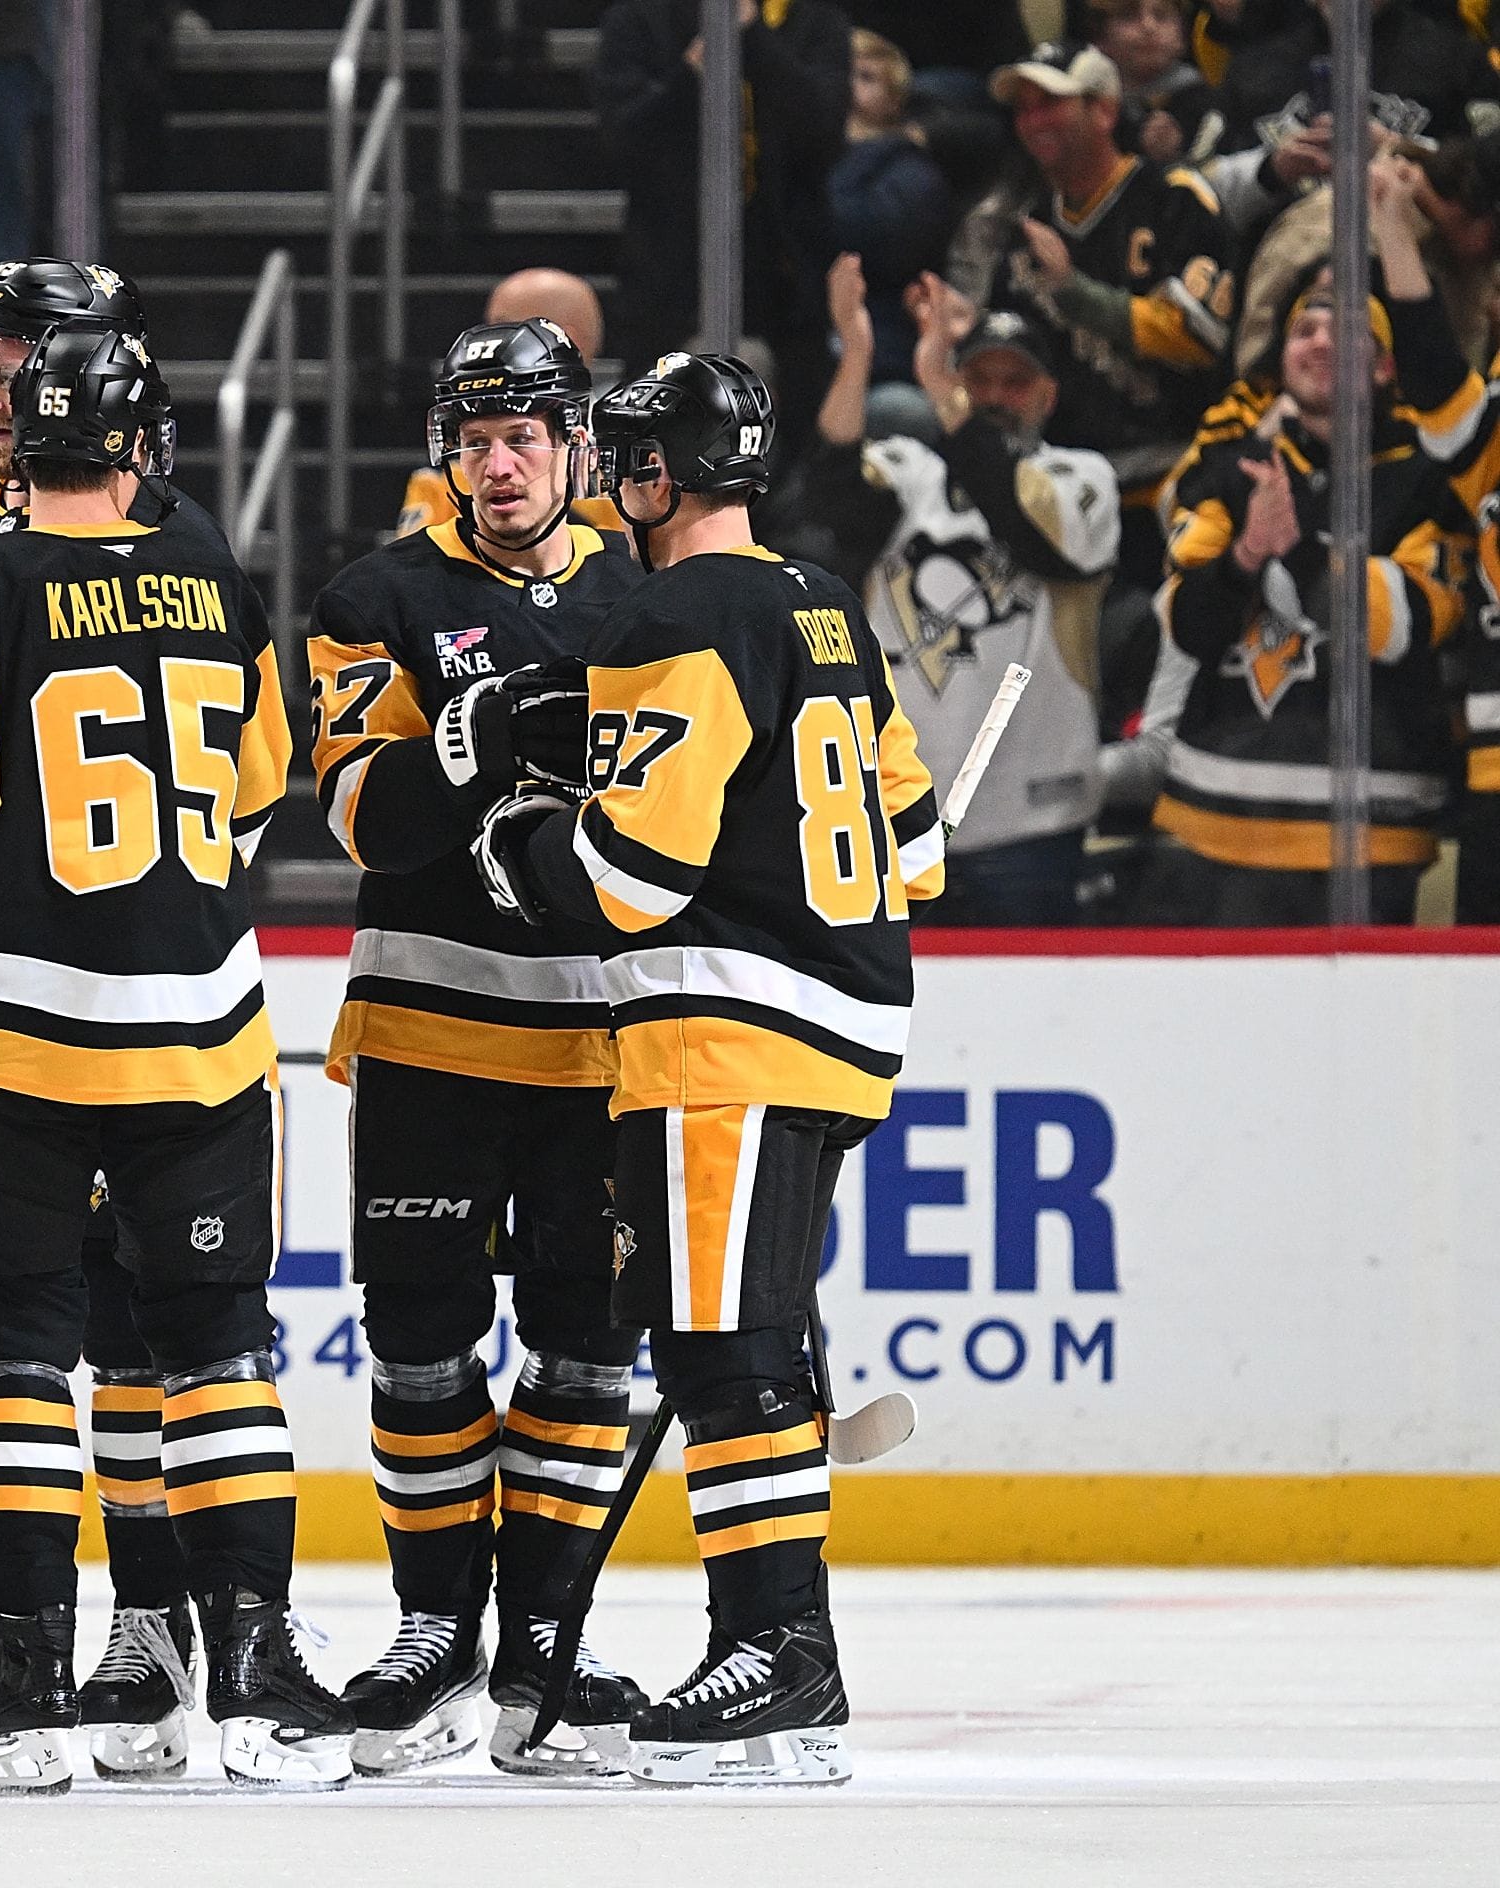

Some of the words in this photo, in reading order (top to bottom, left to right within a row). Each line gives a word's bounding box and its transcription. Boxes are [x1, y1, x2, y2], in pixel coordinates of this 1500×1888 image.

[1128, 227, 1155, 277] C
[458, 377, 504, 391] CCM
[38, 387, 71, 417] 65
[739, 425, 764, 456] 87
[45, 574, 227, 640] KARLSSON
[439, 652, 496, 679] F.N.B.
[588, 710, 693, 792] 87
[30, 657, 245, 896] 65
[366, 1196, 473, 1219] CCM
[721, 1692, 773, 1720] CCM
[803, 1743, 839, 1751] CCM
